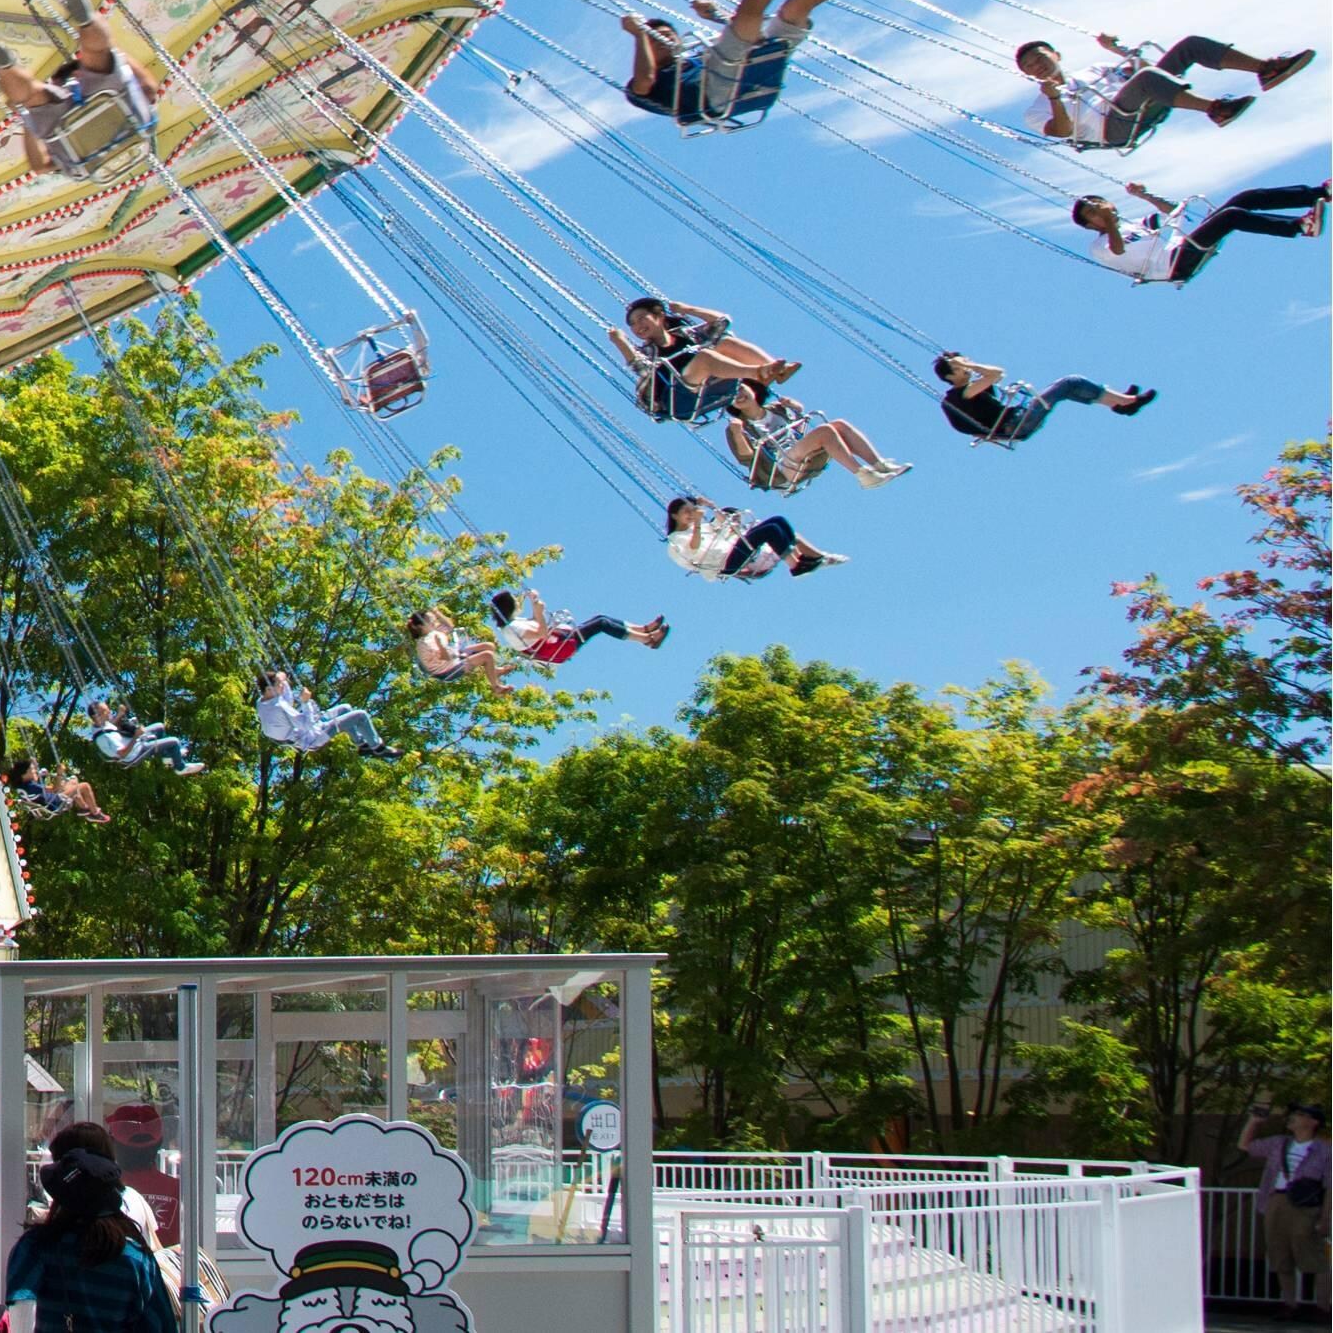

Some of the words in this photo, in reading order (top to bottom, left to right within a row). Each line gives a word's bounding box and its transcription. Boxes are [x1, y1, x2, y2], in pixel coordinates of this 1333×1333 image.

[591, 1113, 616, 1128] 出口
[293, 1167, 418, 1187] 120cm未満の
[304, 1193, 405, 1208] おともだちは
[301, 1214, 411, 1230] のらないでね!
